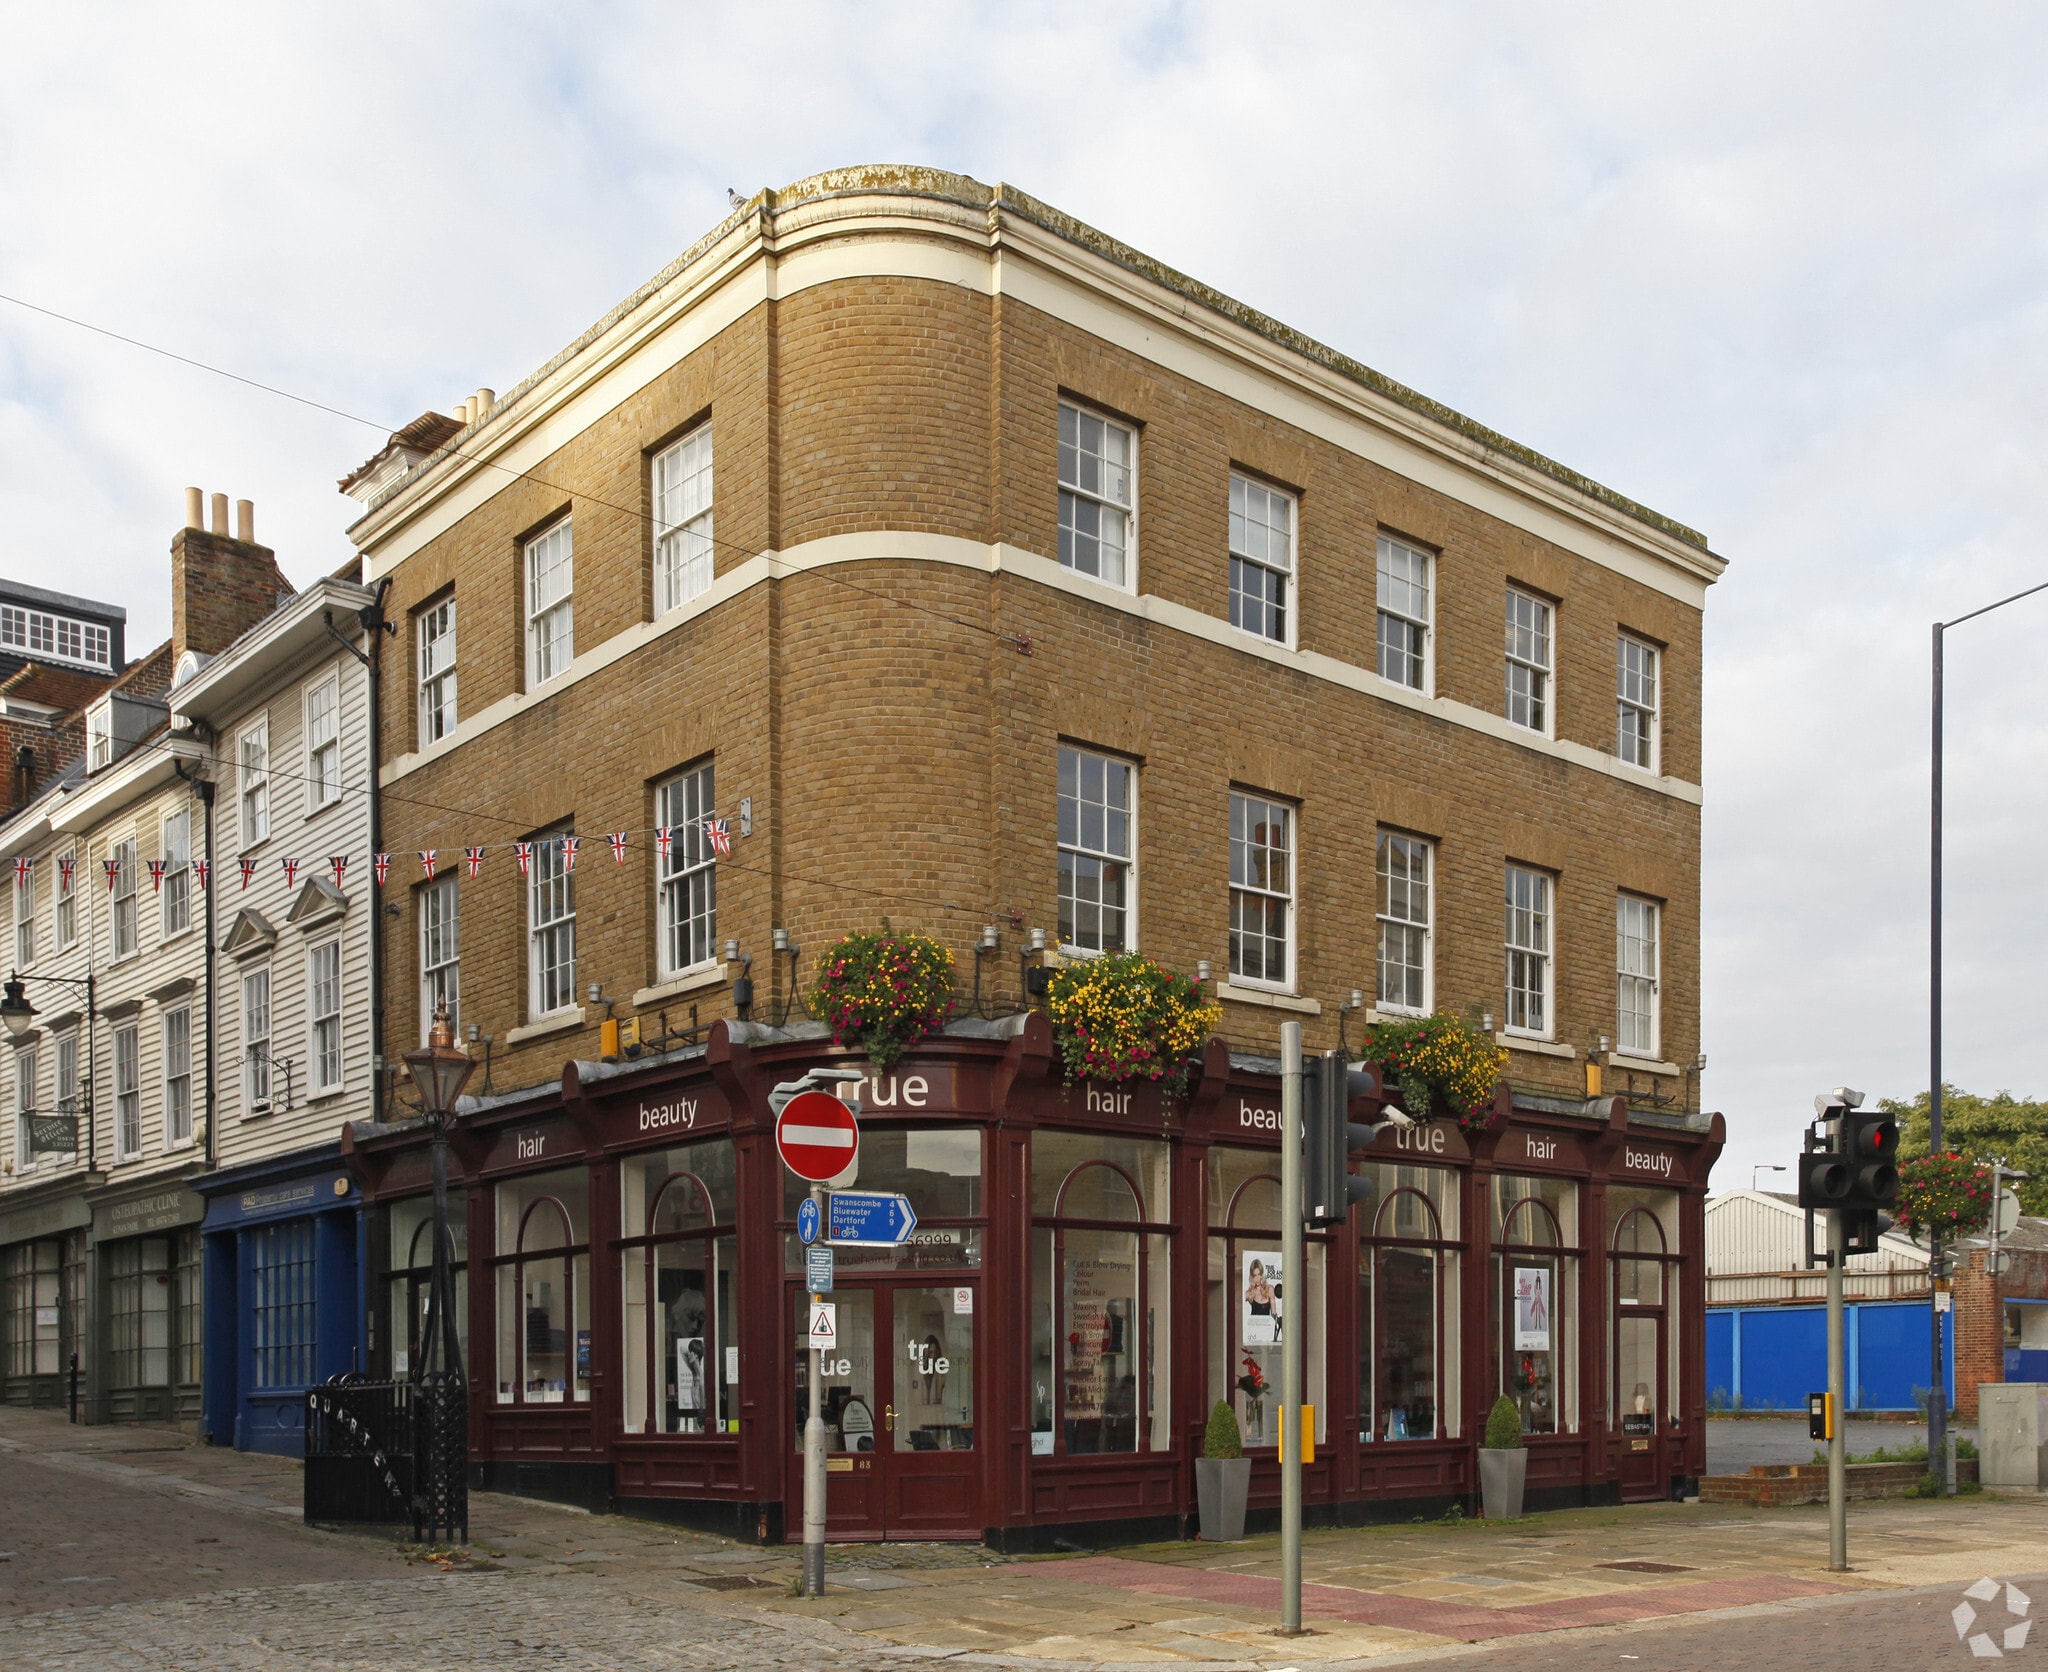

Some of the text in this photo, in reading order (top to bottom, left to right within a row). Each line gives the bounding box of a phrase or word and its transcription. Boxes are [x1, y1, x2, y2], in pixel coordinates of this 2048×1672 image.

[1087, 1082, 1132, 1115] hair
[640, 1097, 697, 1131] beauty
[1240, 1099, 1305, 1139] beau
[518, 1131, 545, 1159] hair
[1526, 1134, 1556, 1159] hair
[1625, 1145, 1673, 1178] beauty
[112, 1198, 156, 1220] OSTEOPATHIC
[157, 1191, 182, 1211] CLINIC
[833, 1198, 882, 1208] Swanscombe
[833, 1207, 895, 1217] Bluewater 6
[833, 1215, 895, 1226] Dartford 9
[1093, 1261, 1109, 1269] Blow
[1110, 1262, 1131, 1272] Drying
[1073, 1270, 1094, 1278] Colour
[1073, 1279, 1090, 1287] Perm
[1073, 1288, 1091, 1296] Bridal
[1073, 1303, 1097, 1312] Waxing
[859, 1460, 871, 1469] 83
